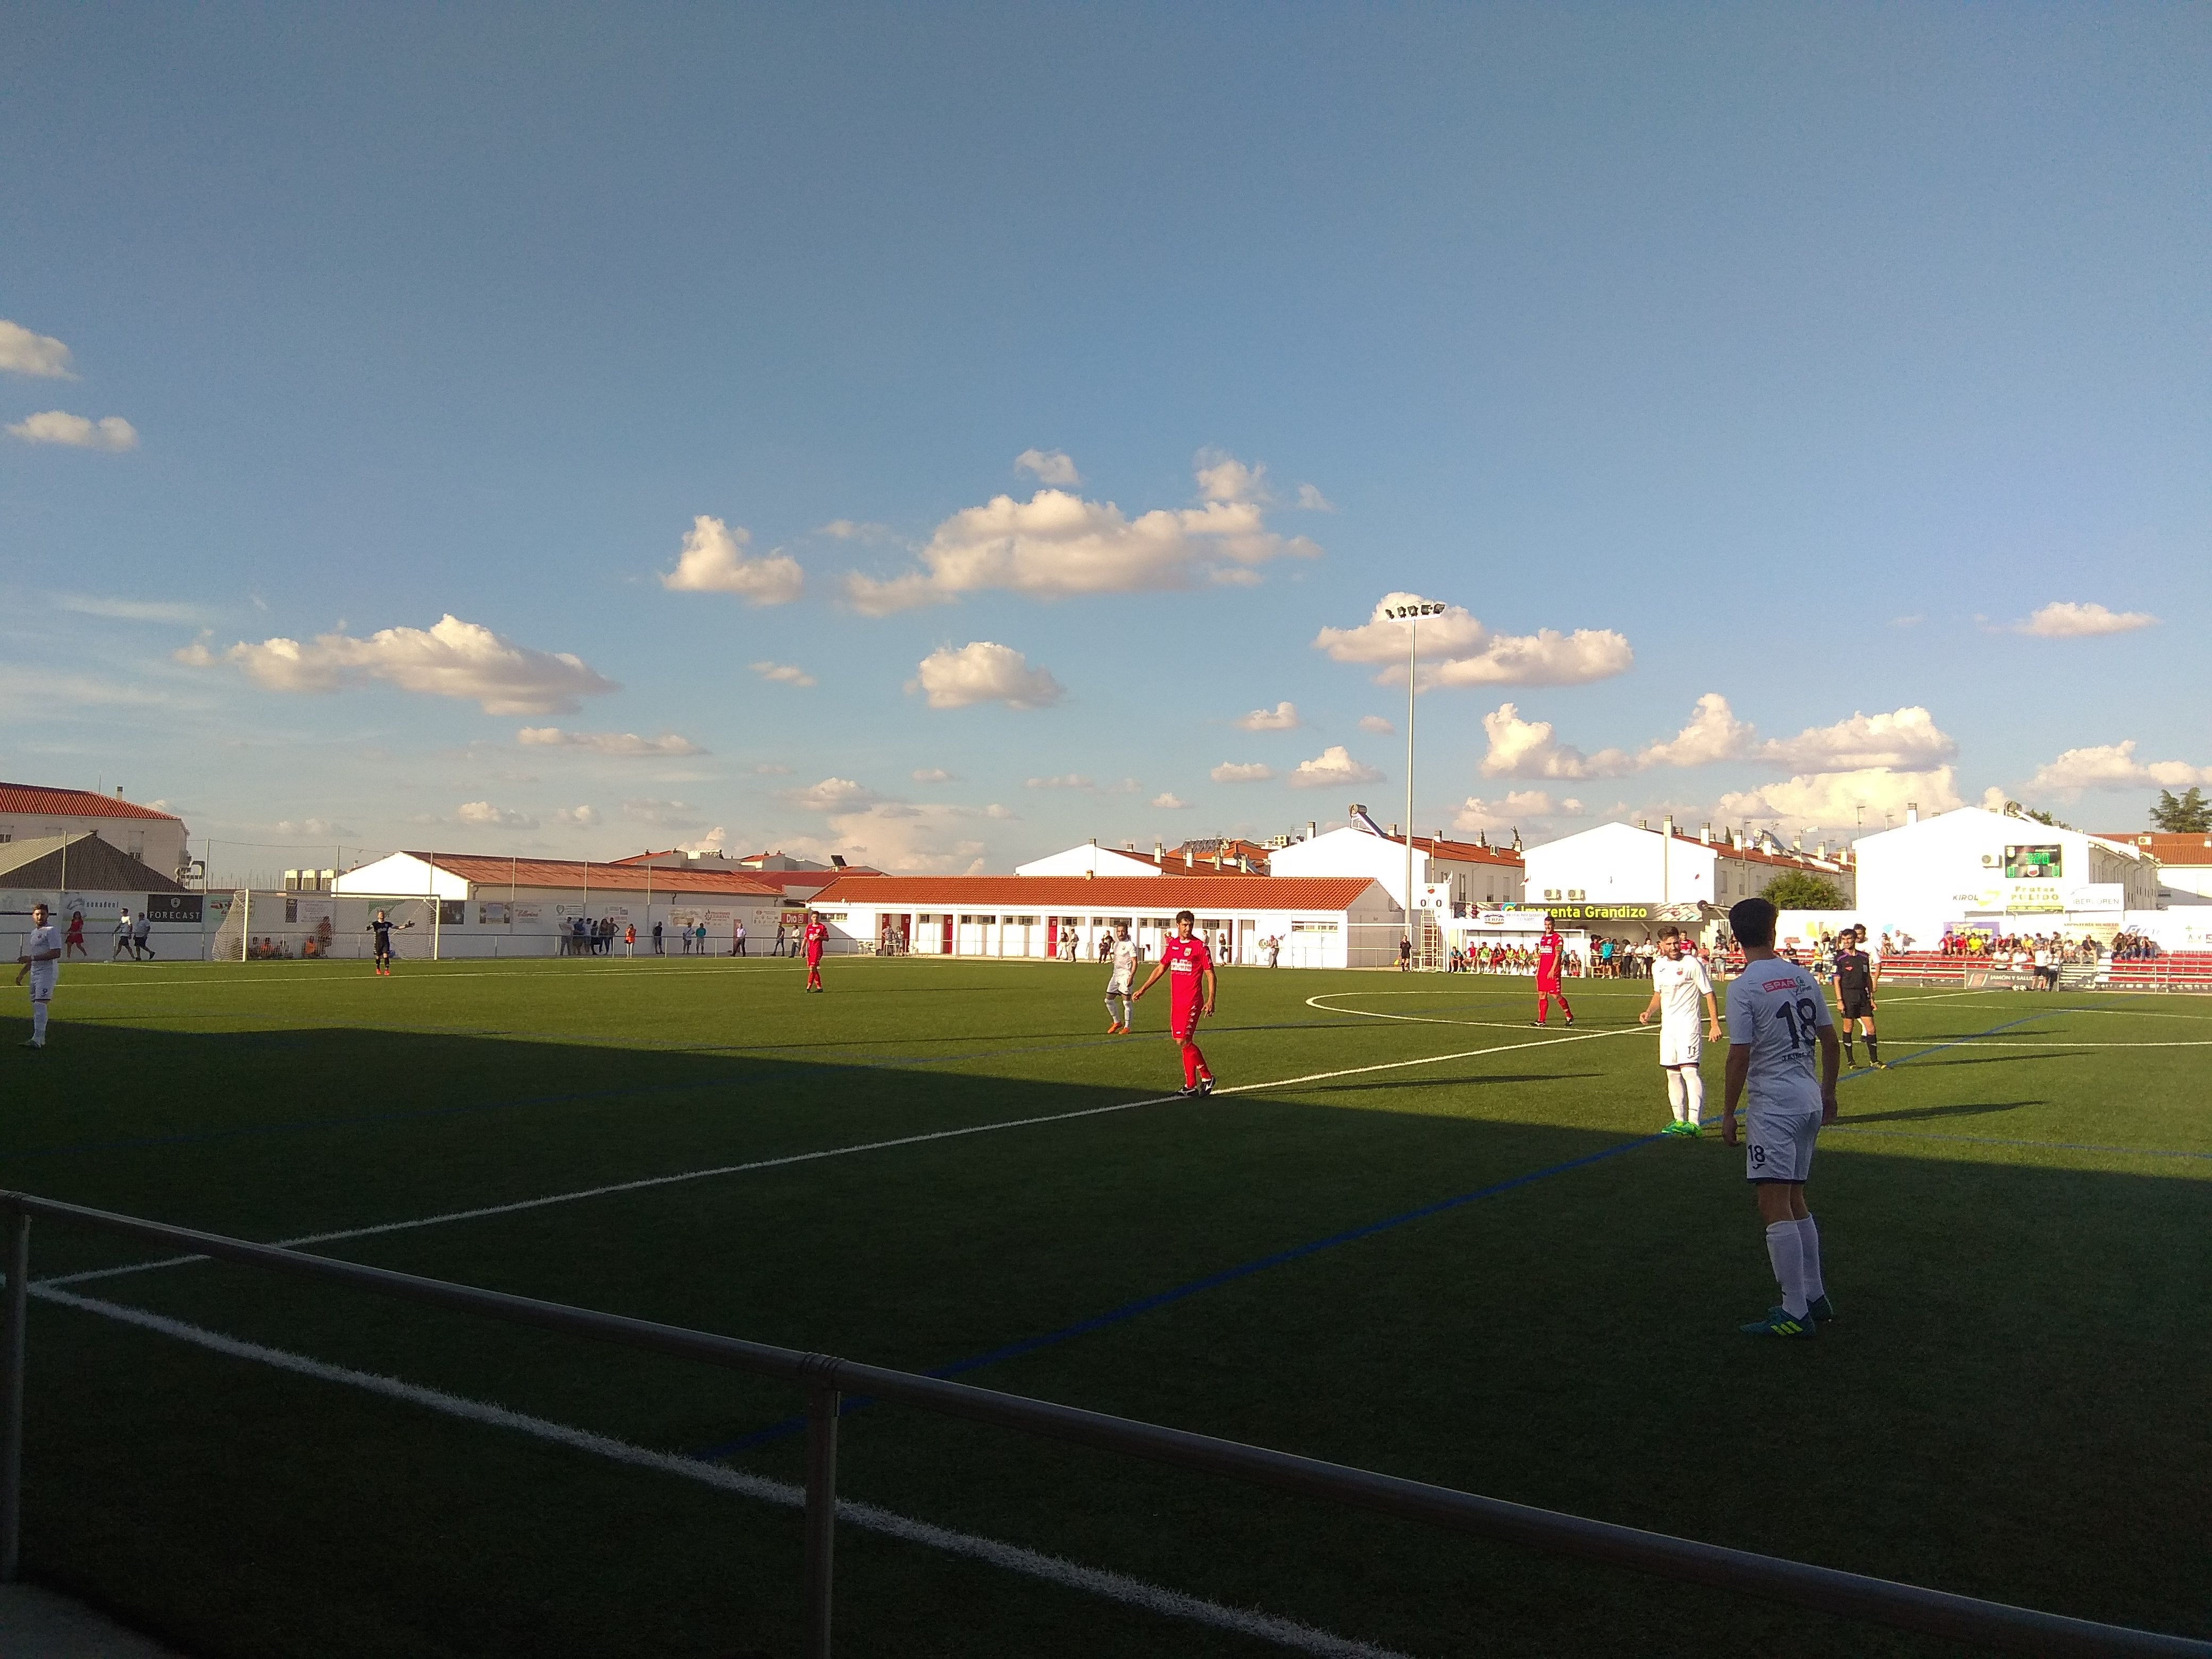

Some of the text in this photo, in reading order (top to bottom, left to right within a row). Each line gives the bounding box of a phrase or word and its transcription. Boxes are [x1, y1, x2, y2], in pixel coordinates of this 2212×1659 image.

[149, 911, 200, 919] FORECAST
[1521, 905, 1647, 918] enta Grandizo
[1764, 979, 1796, 991] SPAR
[1775, 998, 1816, 1049] 18
[1748, 1144, 1765, 1163] 18
